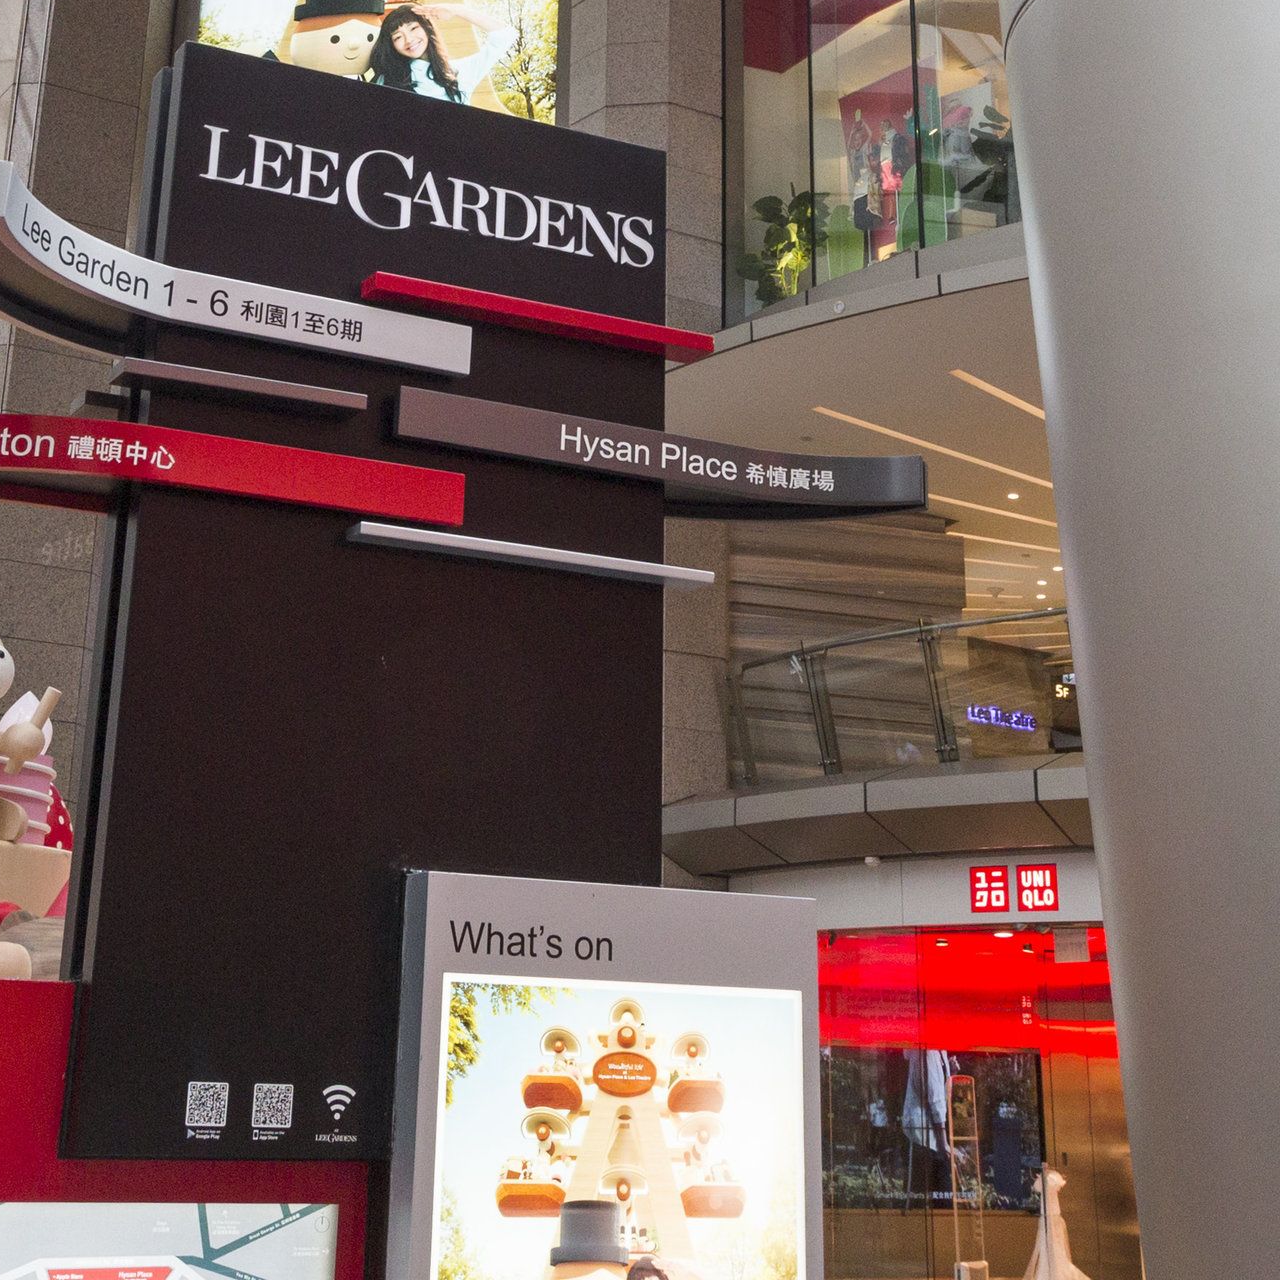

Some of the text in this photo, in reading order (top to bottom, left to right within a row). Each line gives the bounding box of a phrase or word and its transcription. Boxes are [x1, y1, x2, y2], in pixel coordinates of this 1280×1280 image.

[21, 203, 363, 344] Lee Garden 1 - 6 利園1至6期
[67, 435, 176, 470] 禮頓中心
[559, 423, 836, 492] Hysan Place 希慎廣場
[1055, 684, 1070, 698] 5F
[968, 703, 1037, 732] Lee Theatre
[1021, 870, 1051, 887] UNI
[1022, 889, 1054, 909] QLO
[450, 920, 613, 961] What's on
